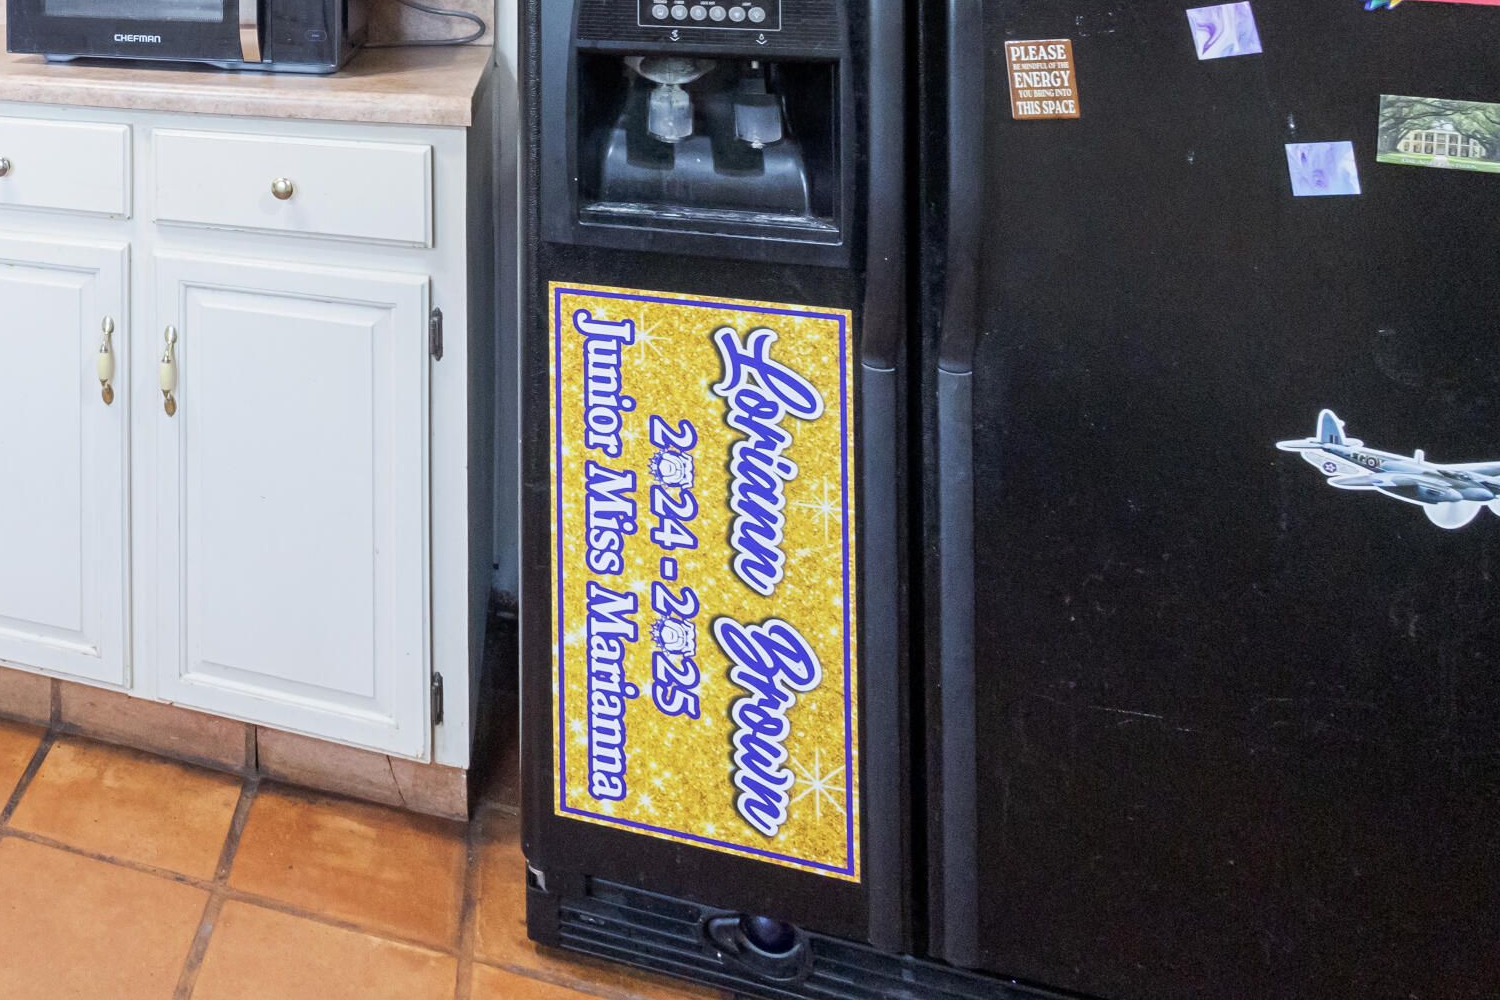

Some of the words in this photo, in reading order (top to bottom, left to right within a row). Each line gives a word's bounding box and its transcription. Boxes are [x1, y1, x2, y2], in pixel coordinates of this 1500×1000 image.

[114, 33, 161, 43] CHEFMAN
[1010, 44, 1067, 61] PLEASE
[1021, 62, 1048, 70] MINDFUL
[1057, 61, 1069, 69] THE
[1013, 70, 1070, 88] ENERGY
[1018, 89, 1033, 98] YOU
[1033, 88, 1054, 98] BRING
[1055, 88, 1072, 97] INTO
[1016, 100, 1041, 115] THIS
[1041, 99, 1077, 114] SPACE
[574, 309, 636, 458] Junior
[713, 326, 825, 596] Loriann
[585, 460, 638, 575] Miss
[586, 581, 640, 800] Marianna
[713, 615, 823, 838] Brown
